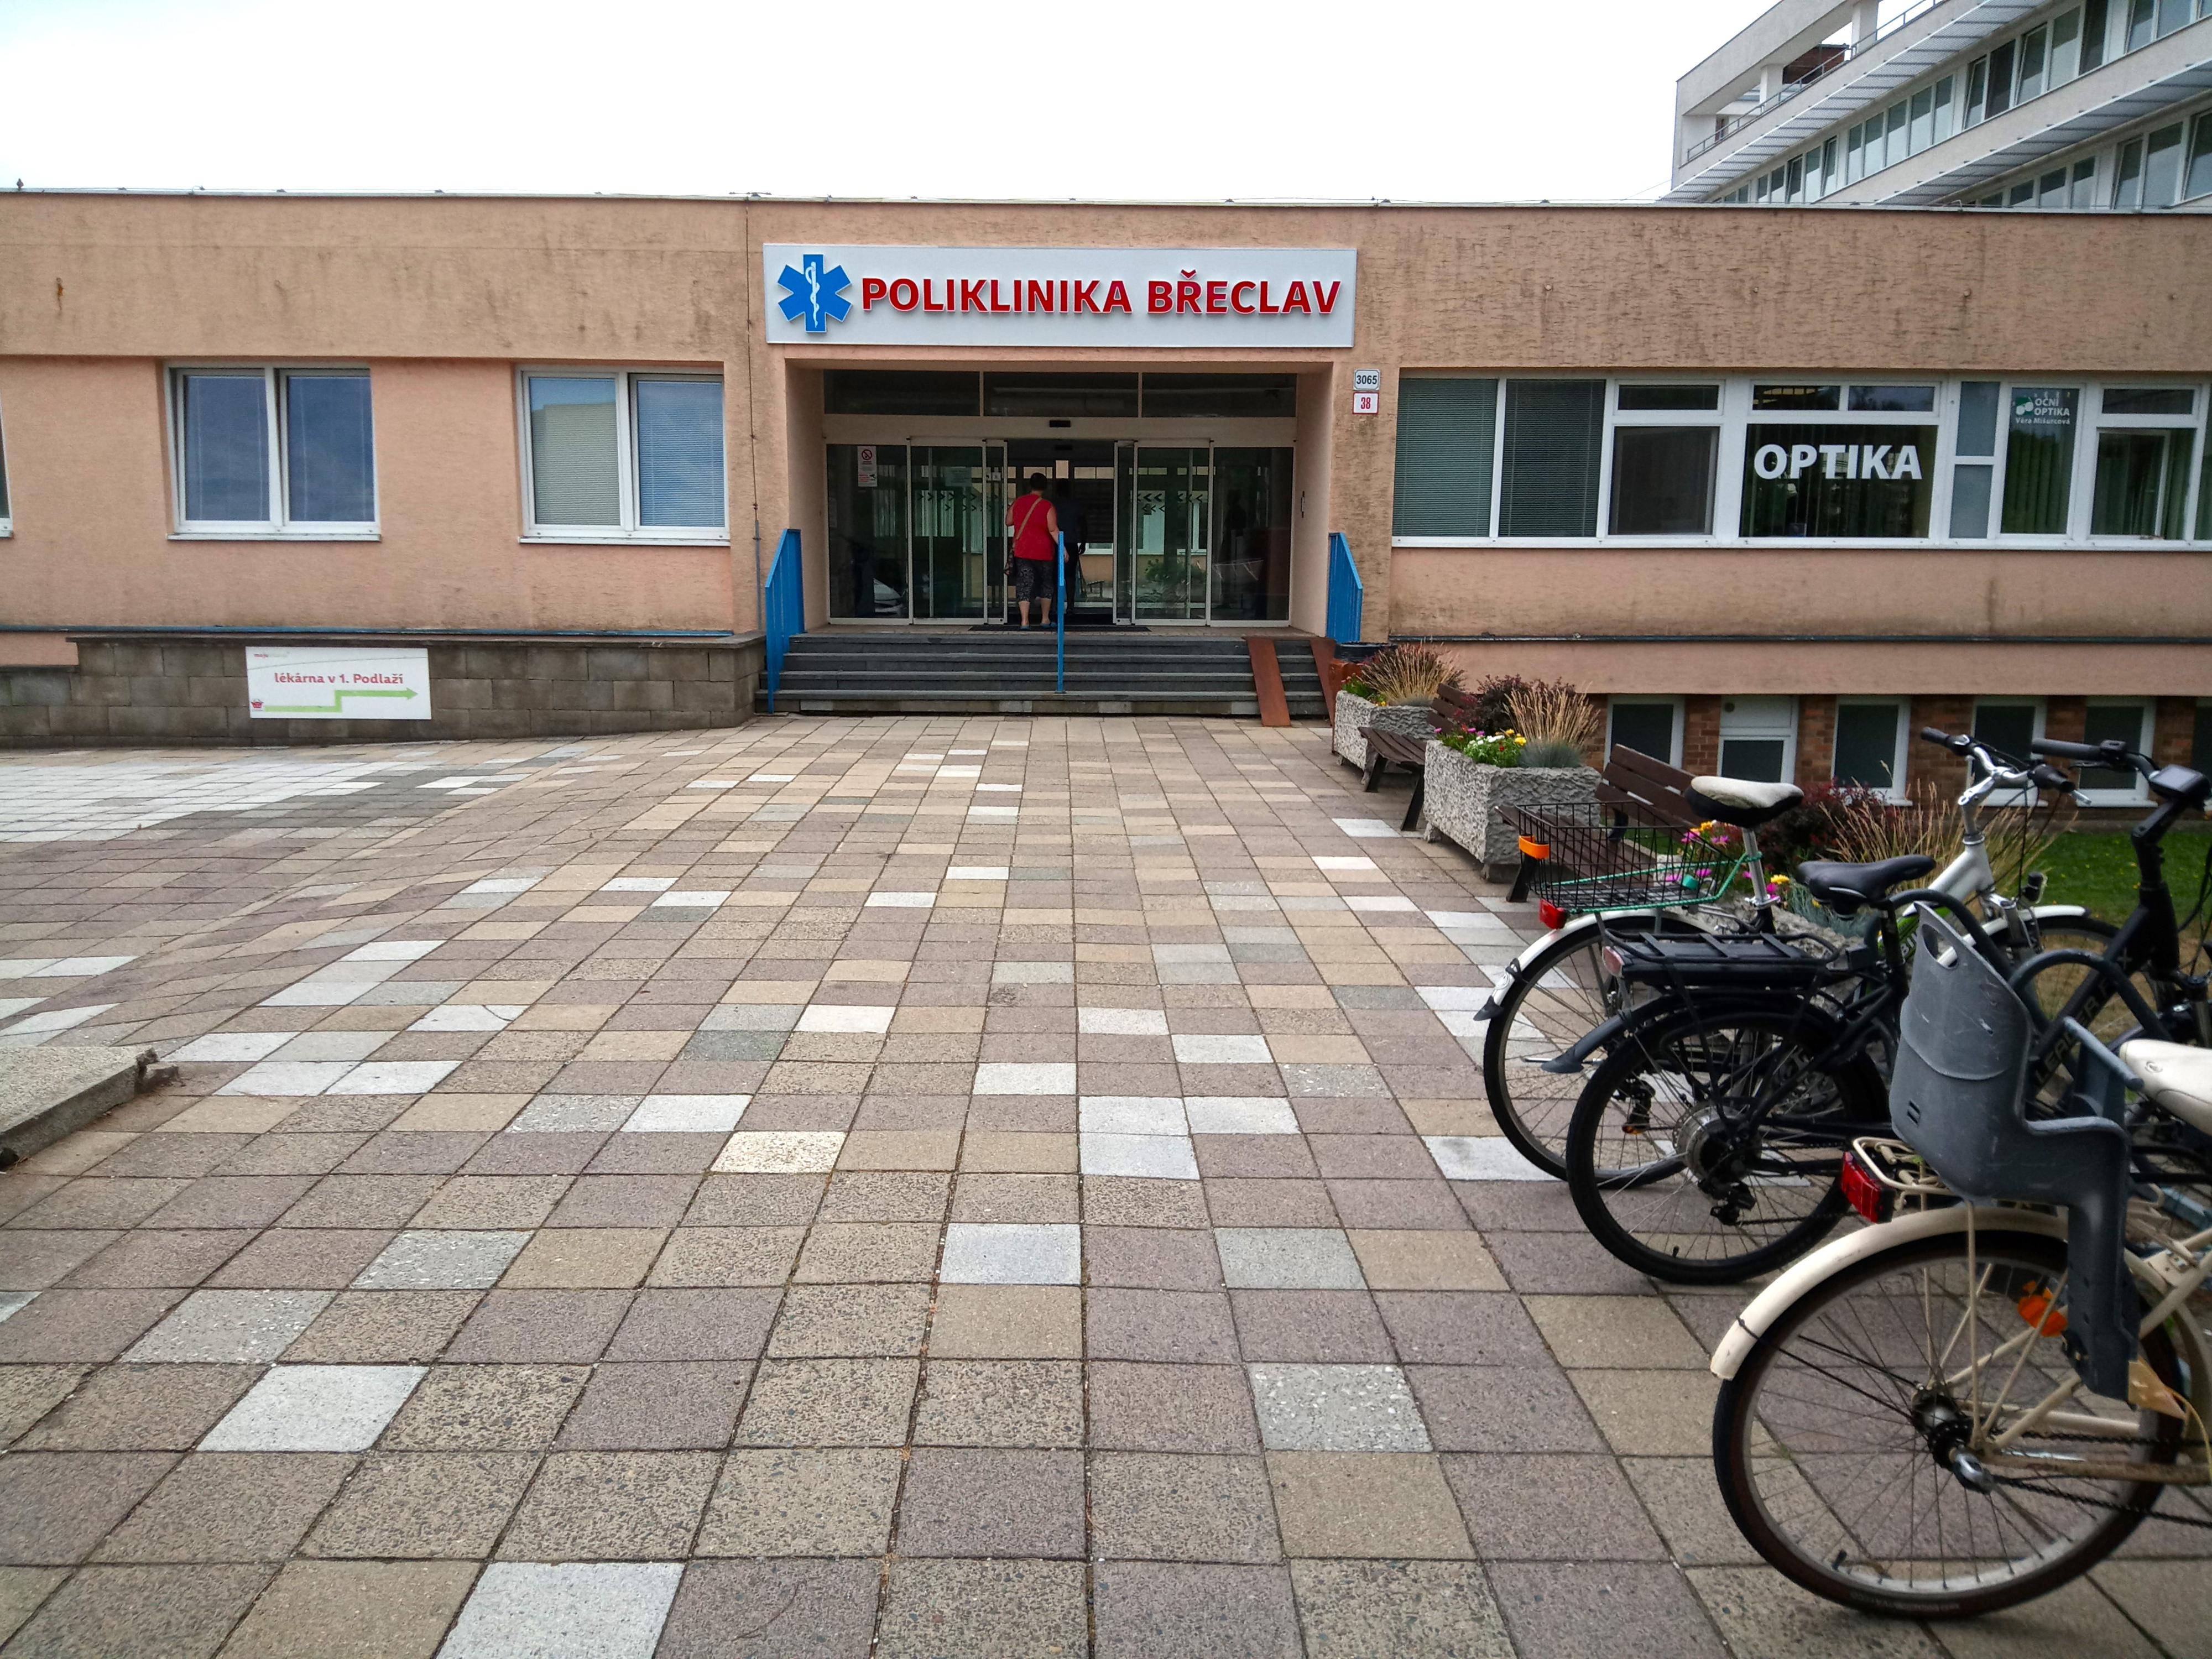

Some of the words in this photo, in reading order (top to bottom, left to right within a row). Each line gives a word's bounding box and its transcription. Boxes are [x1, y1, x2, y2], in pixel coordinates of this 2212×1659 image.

[862, 276, 1133, 314] POLIKLINIKA
[1147, 269, 1342, 315] BŘECLAV
[1357, 375, 1377, 384] 3065
[1360, 397, 1371, 409] 38
[2034, 408, 2070, 416] OPTIKA
[1754, 444, 1923, 480] OPTIKA
[274, 673, 325, 684] lékárna
[340, 674, 349, 684] 1.
[353, 674, 403, 684] Podlaží
